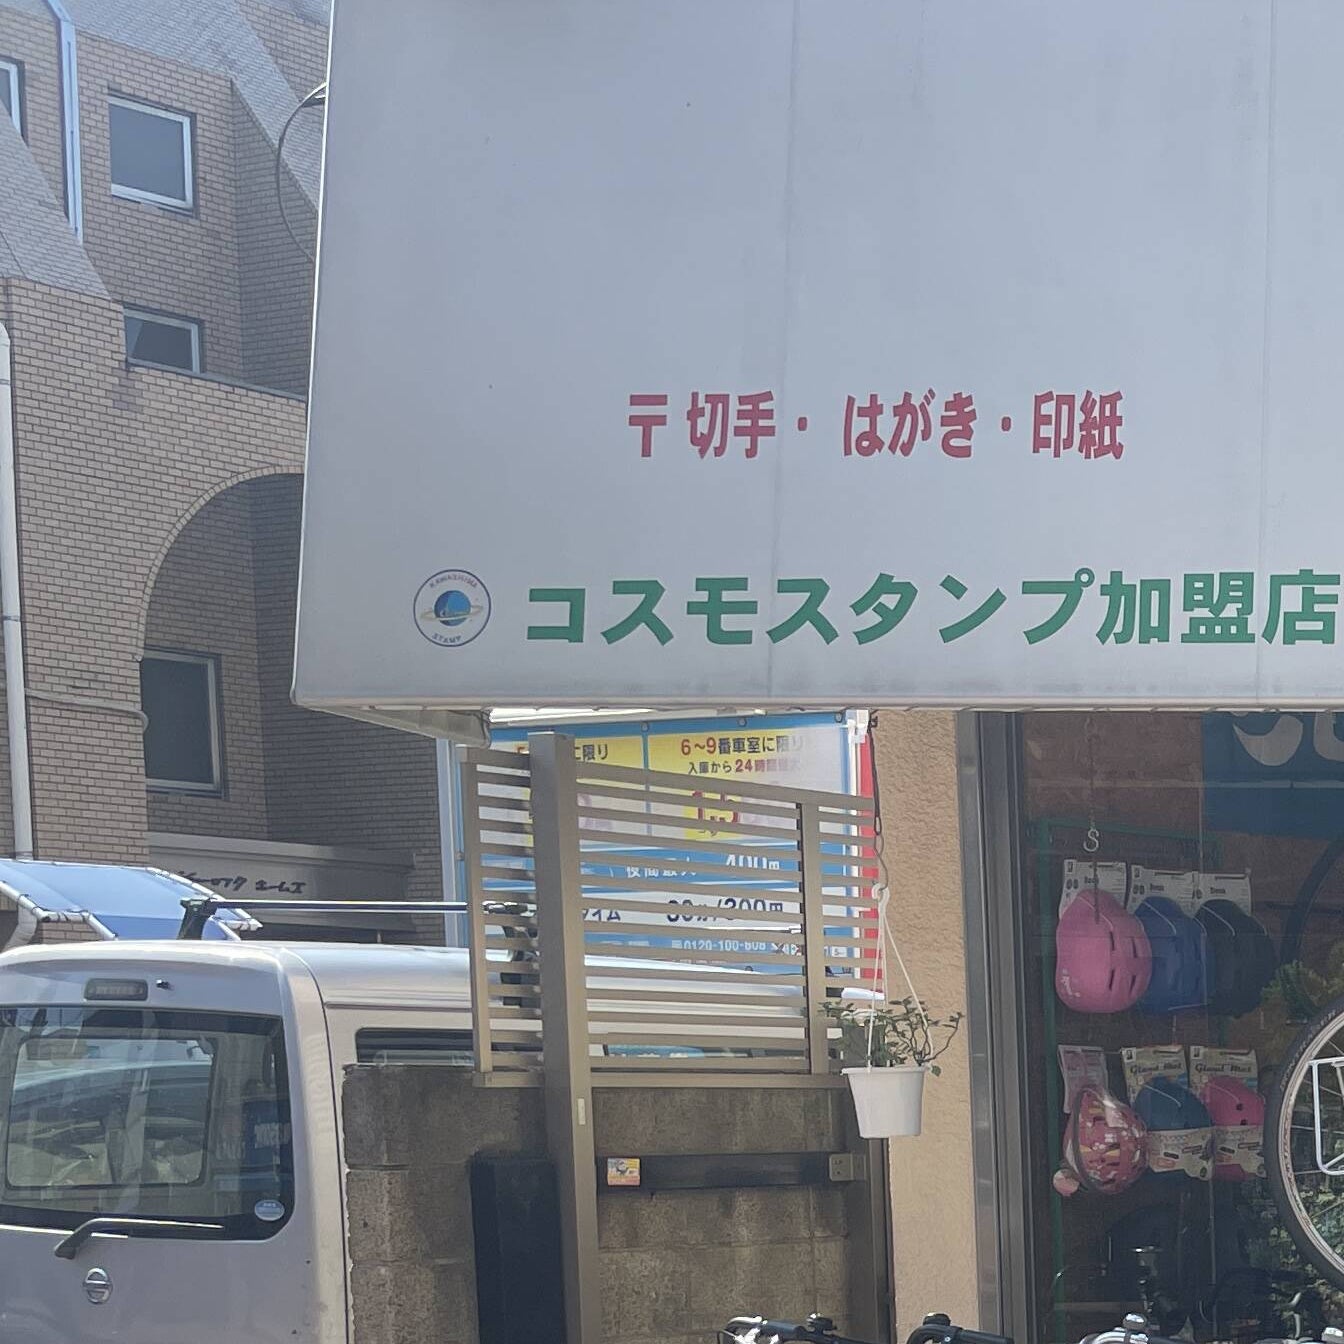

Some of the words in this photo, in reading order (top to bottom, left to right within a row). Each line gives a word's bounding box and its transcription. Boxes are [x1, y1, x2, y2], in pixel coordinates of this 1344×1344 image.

[527, 567, 1342, 647] コスモスタンプ加盟店
